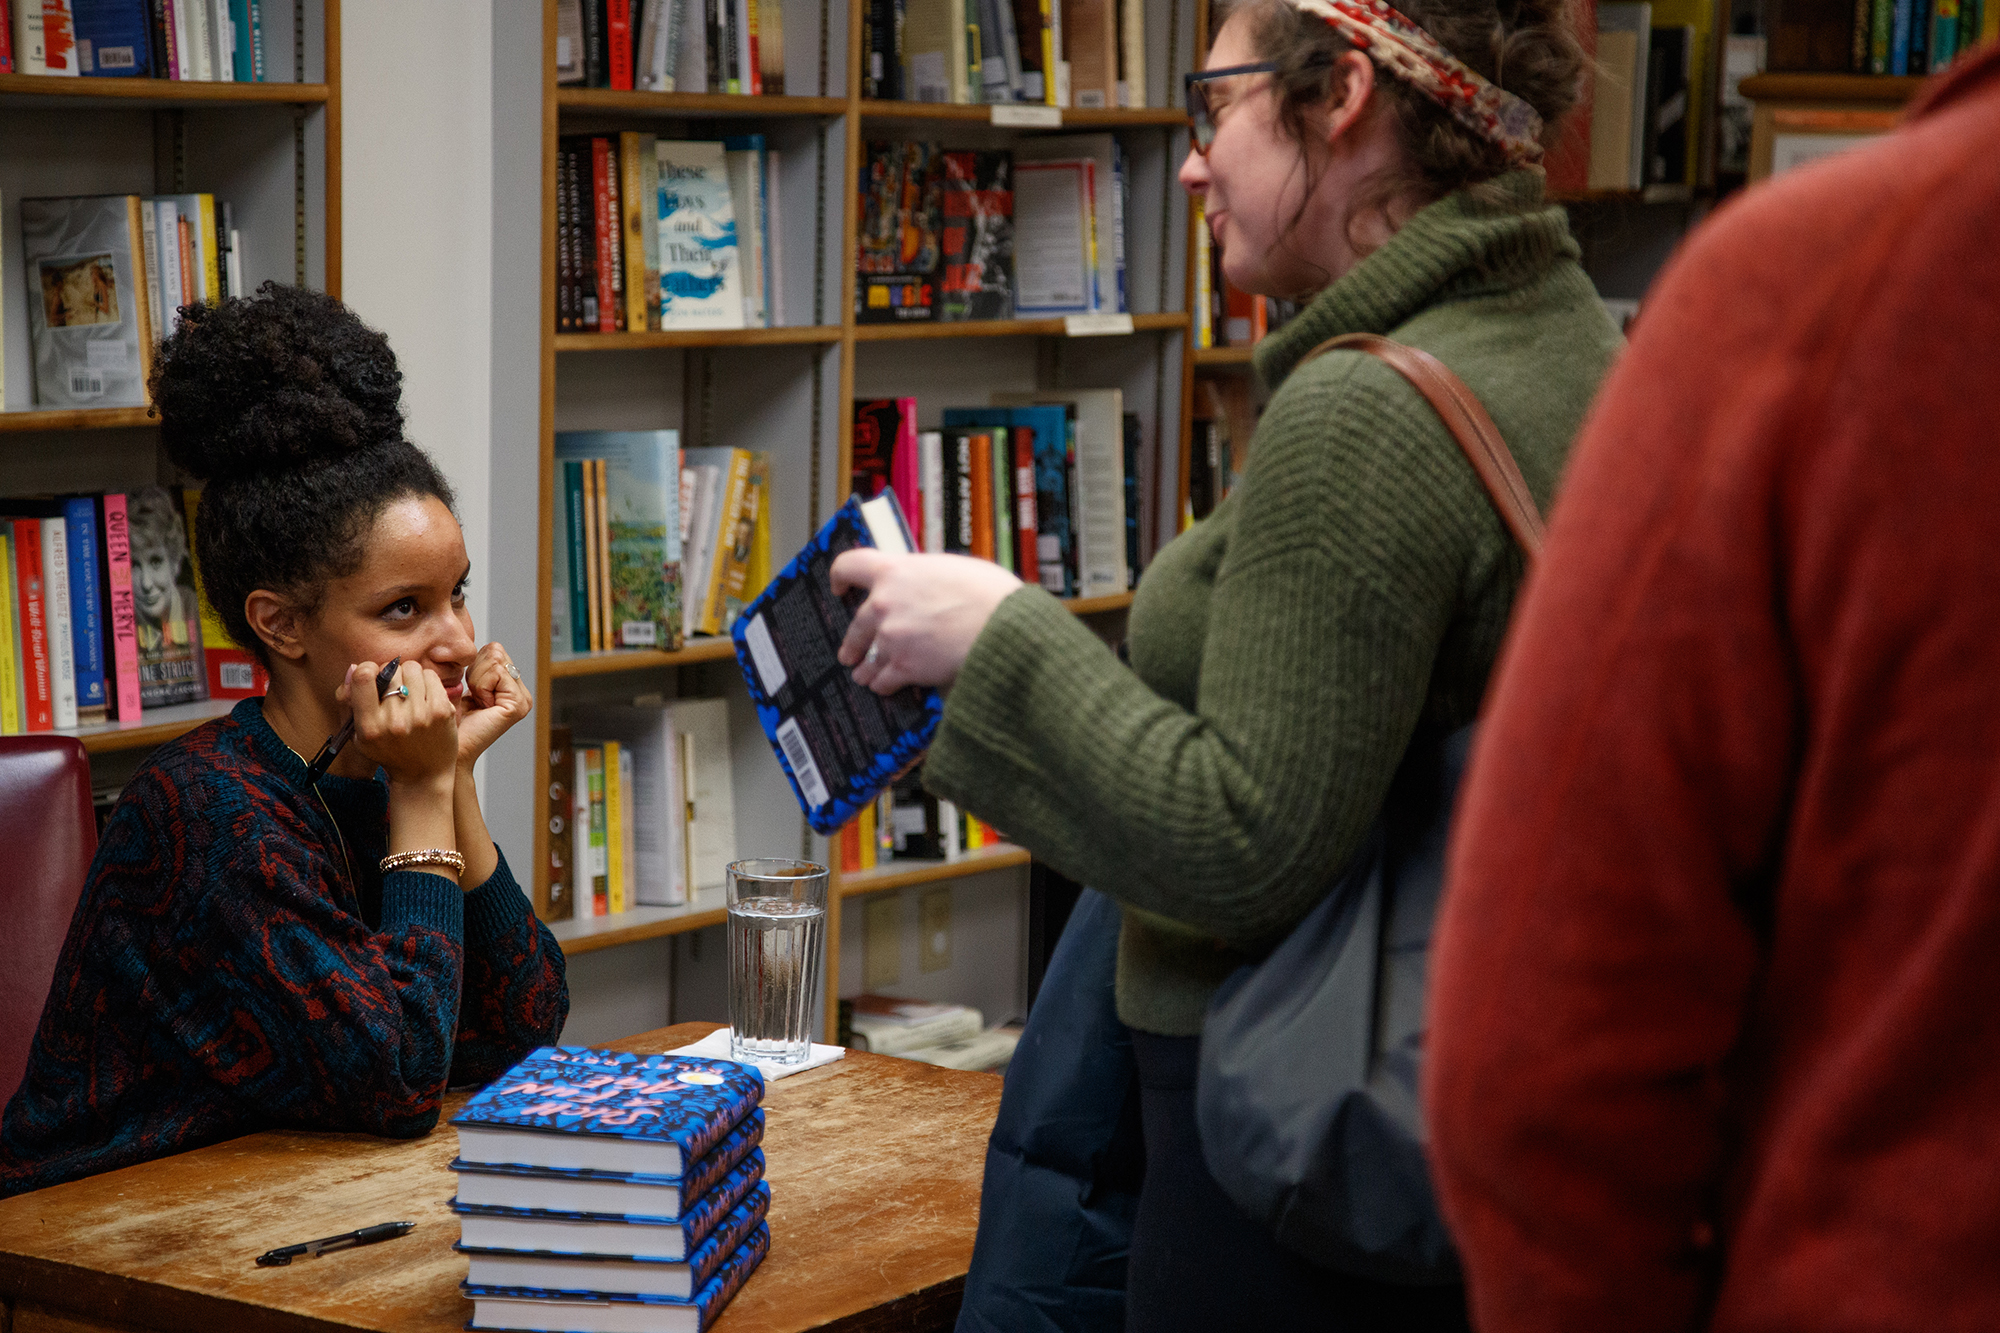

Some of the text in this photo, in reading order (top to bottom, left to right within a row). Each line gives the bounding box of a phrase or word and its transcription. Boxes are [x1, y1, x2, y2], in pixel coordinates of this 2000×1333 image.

[109, 511, 135, 642] QUEEN MERYL
[550, 1054, 621, 1067] REID
[570, 1076, 690, 1094] AGE
